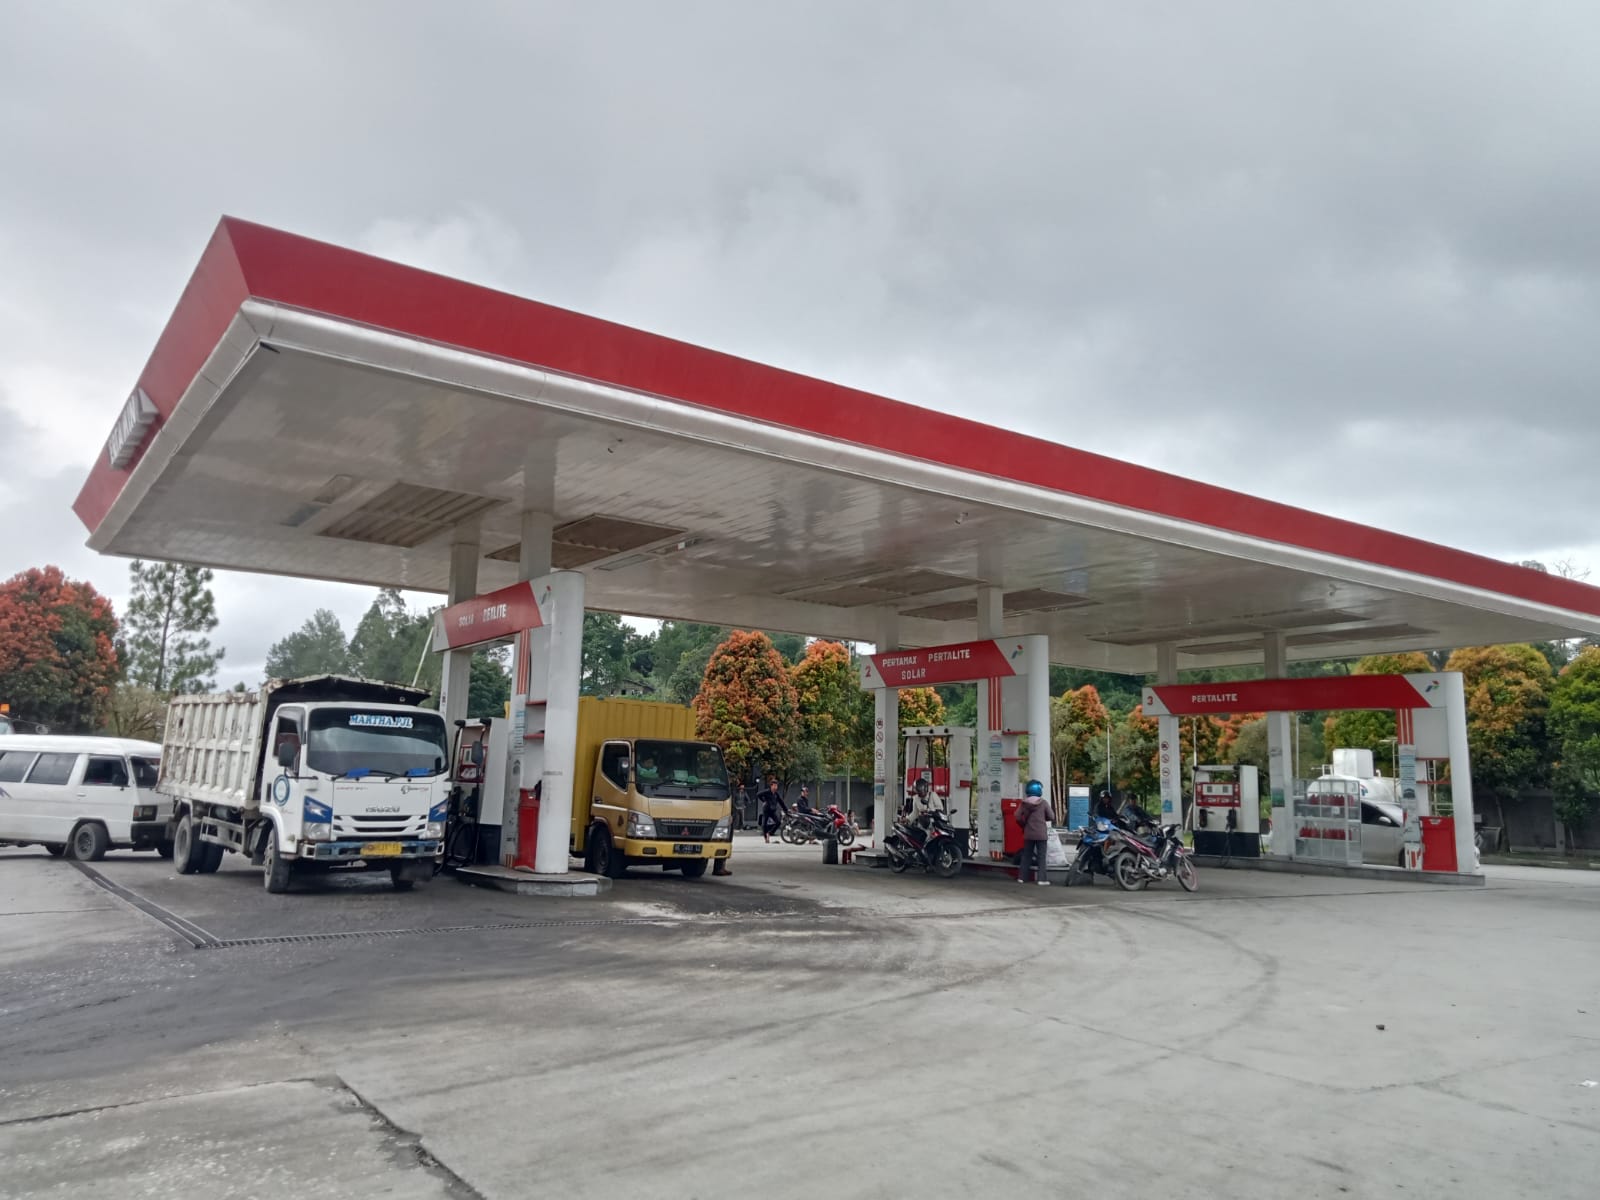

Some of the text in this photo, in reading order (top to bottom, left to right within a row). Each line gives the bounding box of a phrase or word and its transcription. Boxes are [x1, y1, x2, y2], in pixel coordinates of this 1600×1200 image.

[882, 649, 970, 667] PERTAMAX PERTALITE
[865, 666, 871, 677] 2
[901, 668, 926, 680] SOLAR
[1147, 696, 1153, 705] 3
[1191, 693, 1238, 703] PERTALITE
